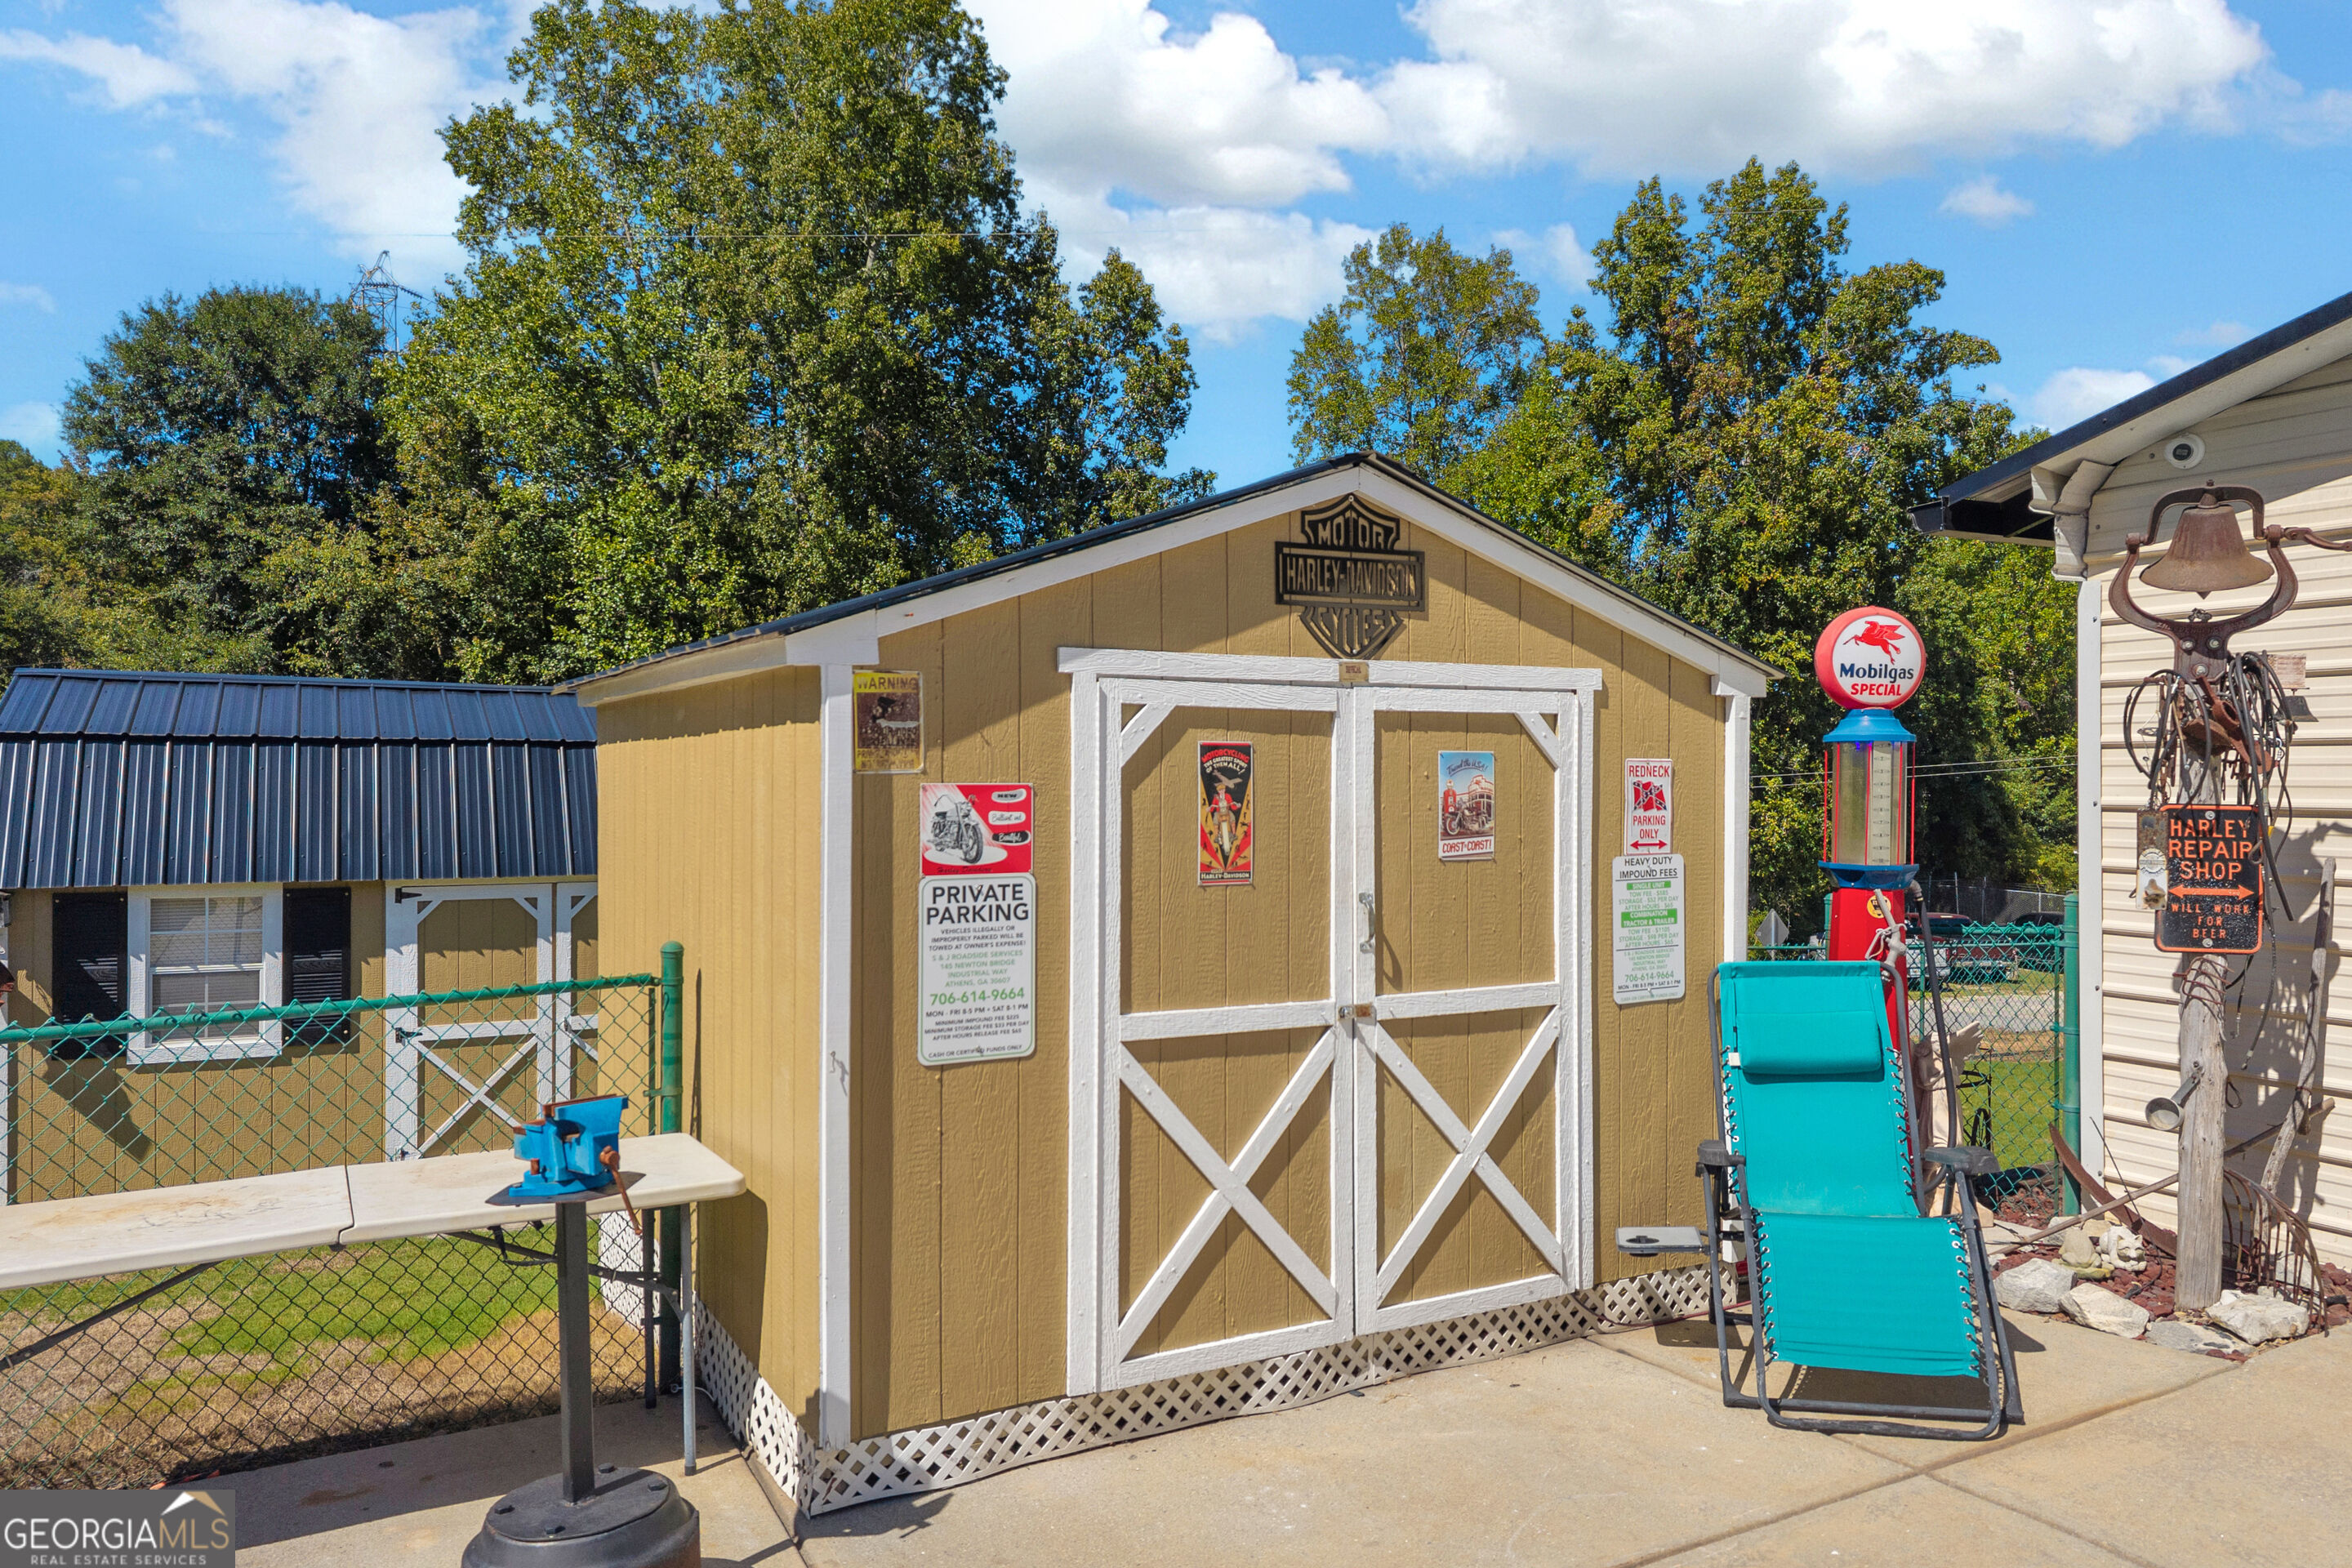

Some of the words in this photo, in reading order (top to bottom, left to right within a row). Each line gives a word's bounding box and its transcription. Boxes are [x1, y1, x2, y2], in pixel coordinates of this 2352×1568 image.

[1318, 510, 1384, 550] MOTOR
[1286, 556, 1416, 597] HARLEY-DAVIDSON
[1317, 607, 1385, 653] CYCLES
[1840, 663, 1914, 684] Mobilgas
[857, 677, 918, 690] WARNING
[1851, 683, 1902, 696] SPECIAL
[1201, 748, 1250, 764] MOTORCYCLING
[1204, 760, 1213, 768] THE
[1234, 758, 1248, 768] SPORT
[1629, 765, 1670, 777] REDNECK
[1633, 815, 1666, 826] PARKING
[1640, 828, 1659, 840] ONLY
[2170, 819, 2250, 839] HARLEY
[2168, 840, 2252, 859] REPAIR
[1624, 858, 1650, 866] HEAVY
[1652, 857, 1673, 865] DUTY
[1619, 870, 1657, 879] IMPOUND
[1659, 868, 1677, 877] FEES
[2180, 862, 2242, 880] SHOP
[933, 884, 1023, 904] PRIVATE
[926, 902, 1029, 925] PARKING
[2171, 903, 2202, 913] WILL
[2214, 904, 2250, 915] WORK
[2198, 915, 2223, 927] FOR
[2193, 929, 2226, 939] BEER
[990, 950, 1023, 958] SERVICES
[1624, 970, 1674, 982] 706-614-9664
[929, 987, 1024, 1006] 706-614-9664
[956, 1048, 985, 1056] CERTIFD
